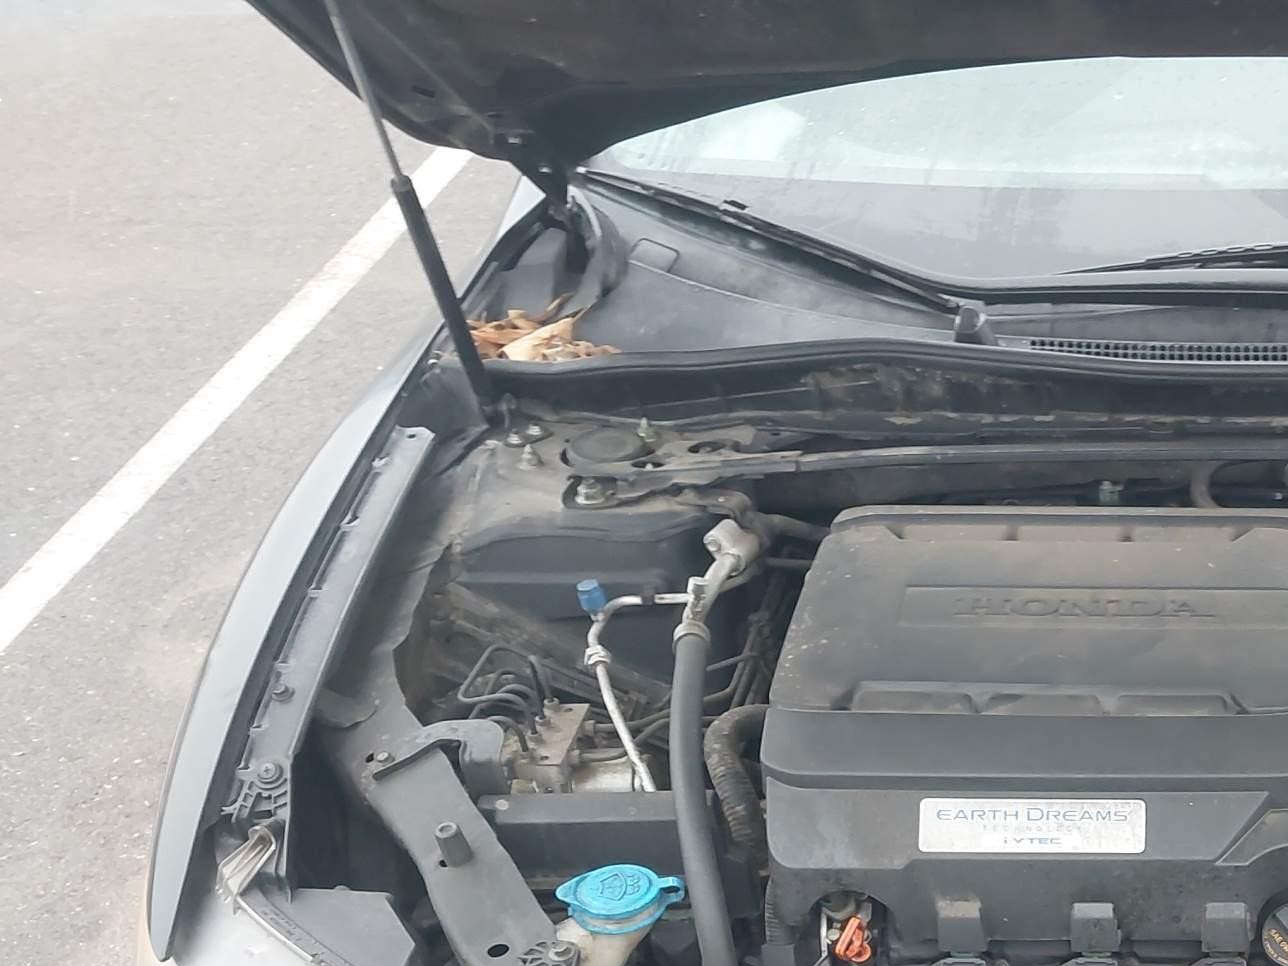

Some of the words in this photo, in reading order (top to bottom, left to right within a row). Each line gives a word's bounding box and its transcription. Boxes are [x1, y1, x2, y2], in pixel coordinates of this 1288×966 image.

[952, 598, 1217, 618] HONDA
[936, 809, 1018, 821] EARTH
[1026, 807, 1128, 822] DREAMS
